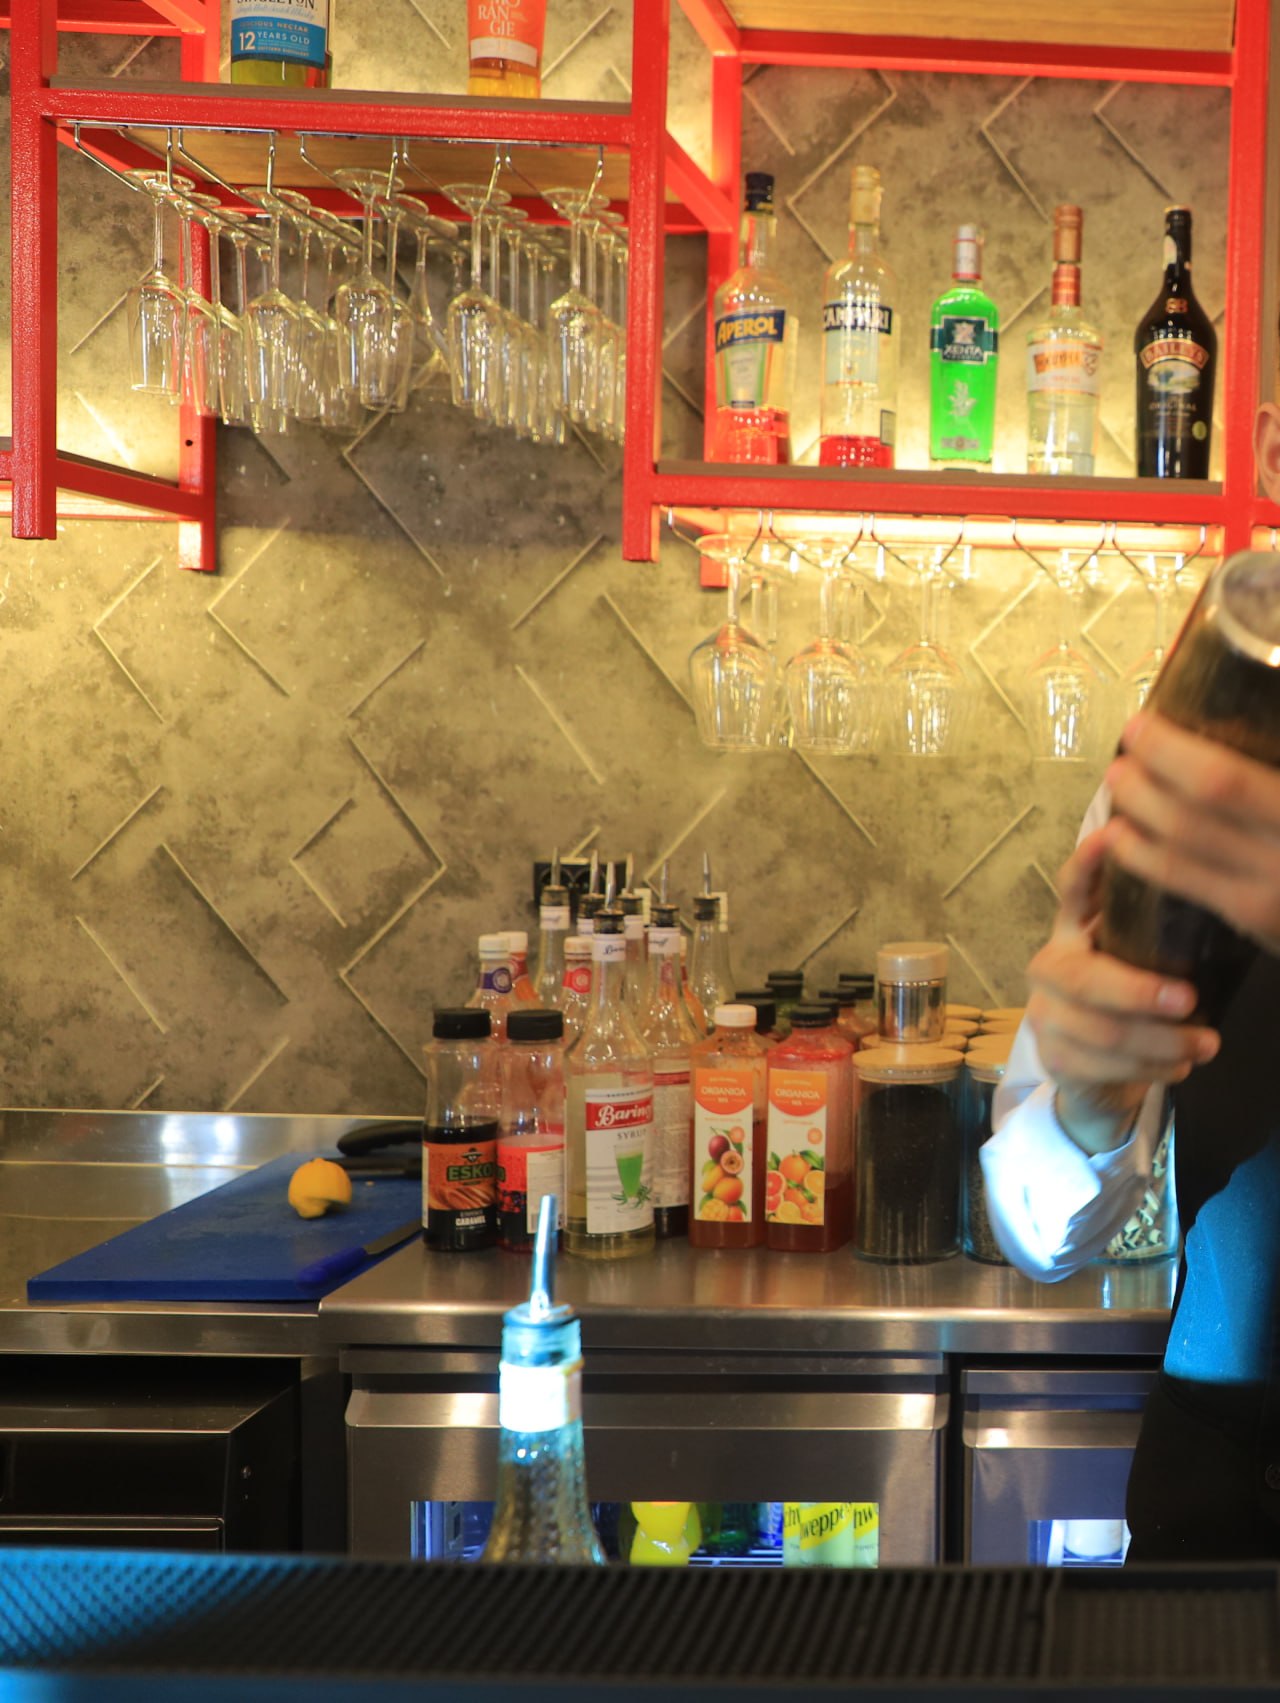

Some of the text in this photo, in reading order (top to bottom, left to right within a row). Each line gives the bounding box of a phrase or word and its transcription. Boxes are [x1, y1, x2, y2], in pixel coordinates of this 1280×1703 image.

[257, 31, 287, 41] YEARS
[290, 34, 310, 46] OLD
[490, 20, 516, 37] GIE
[239, 31, 256, 51] 12
[717, 314, 778, 346] APEROL
[1143, 340, 1205, 364] BAILEYS
